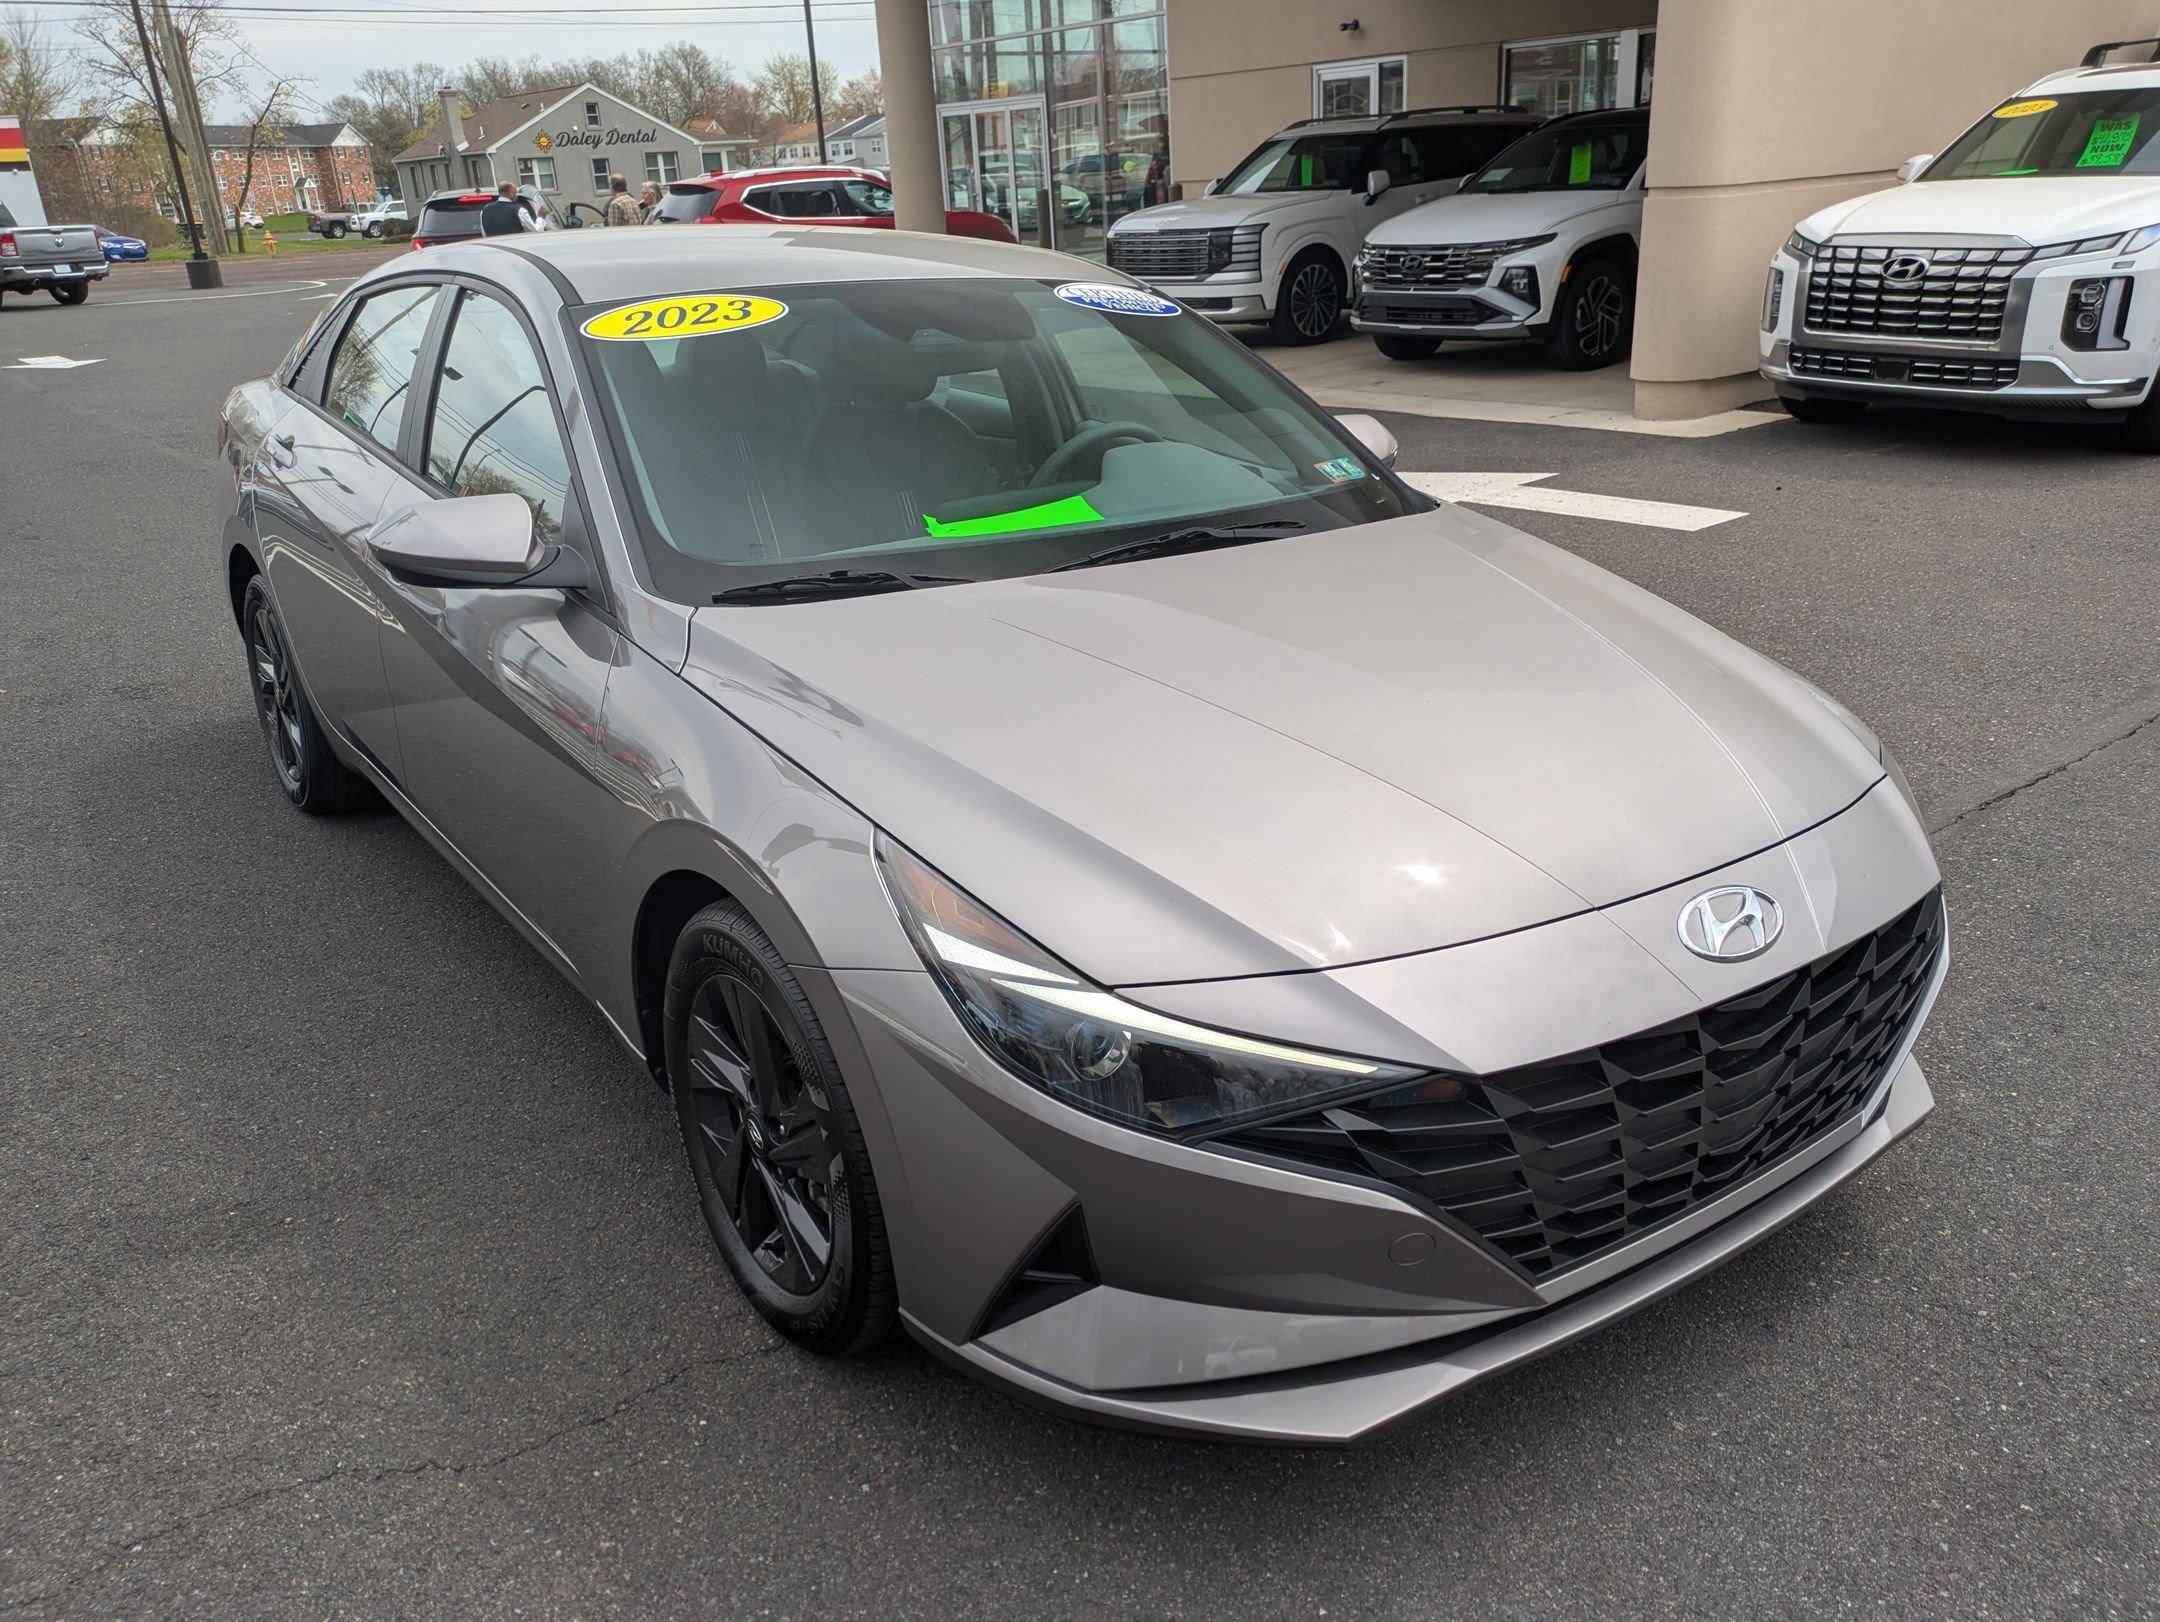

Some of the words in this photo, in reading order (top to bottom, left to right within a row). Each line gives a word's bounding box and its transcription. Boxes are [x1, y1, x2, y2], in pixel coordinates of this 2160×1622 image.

[2100, 121, 2133, 132] WAS
[555, 131, 603, 149] Daley
[605, 128, 657, 146] Dental
[2089, 143, 2126, 153] NOW
[623, 300, 753, 336] 2023
[702, 933, 765, 992] KUMHO
